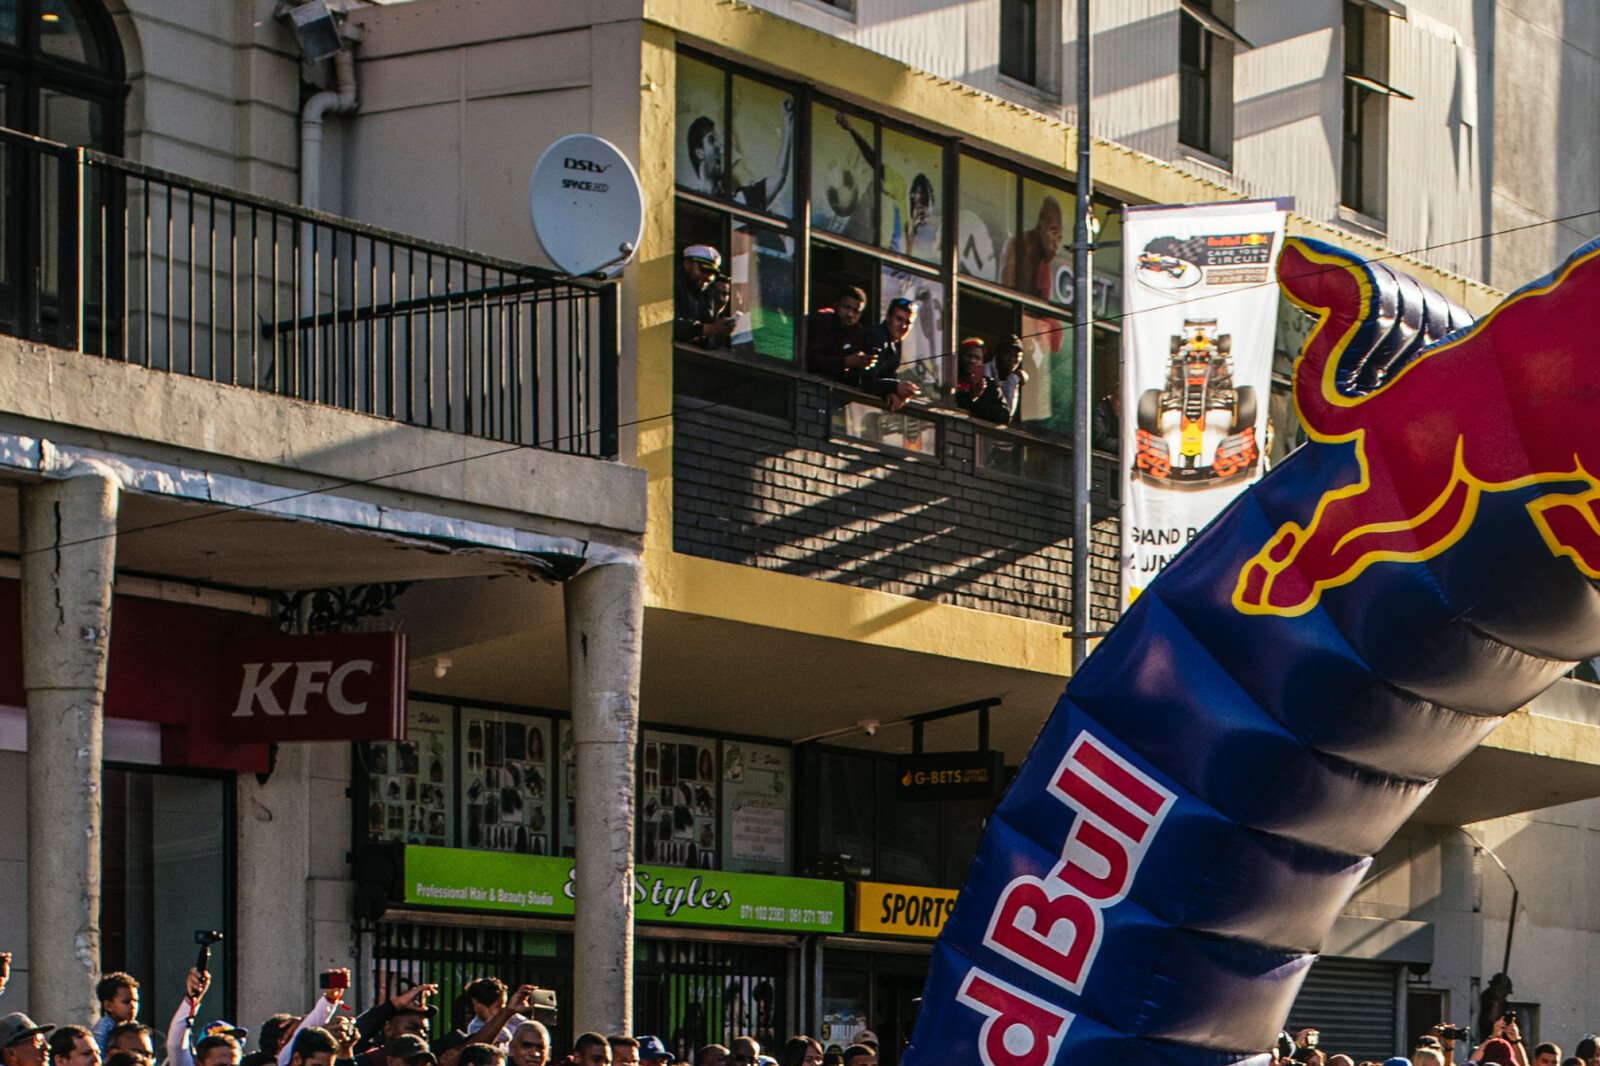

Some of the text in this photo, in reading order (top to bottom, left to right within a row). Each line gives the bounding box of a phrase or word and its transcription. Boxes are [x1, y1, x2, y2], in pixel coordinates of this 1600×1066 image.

[564, 158, 611, 173] DStv
[1208, 255, 1268, 265] CIRCUIT
[232, 659, 373, 717] KFC
[914, 769, 962, 785] G-BETS
[986, 734, 1172, 990] Bull
[416, 883, 554, 907] Professional Hair & Beauty Studio
